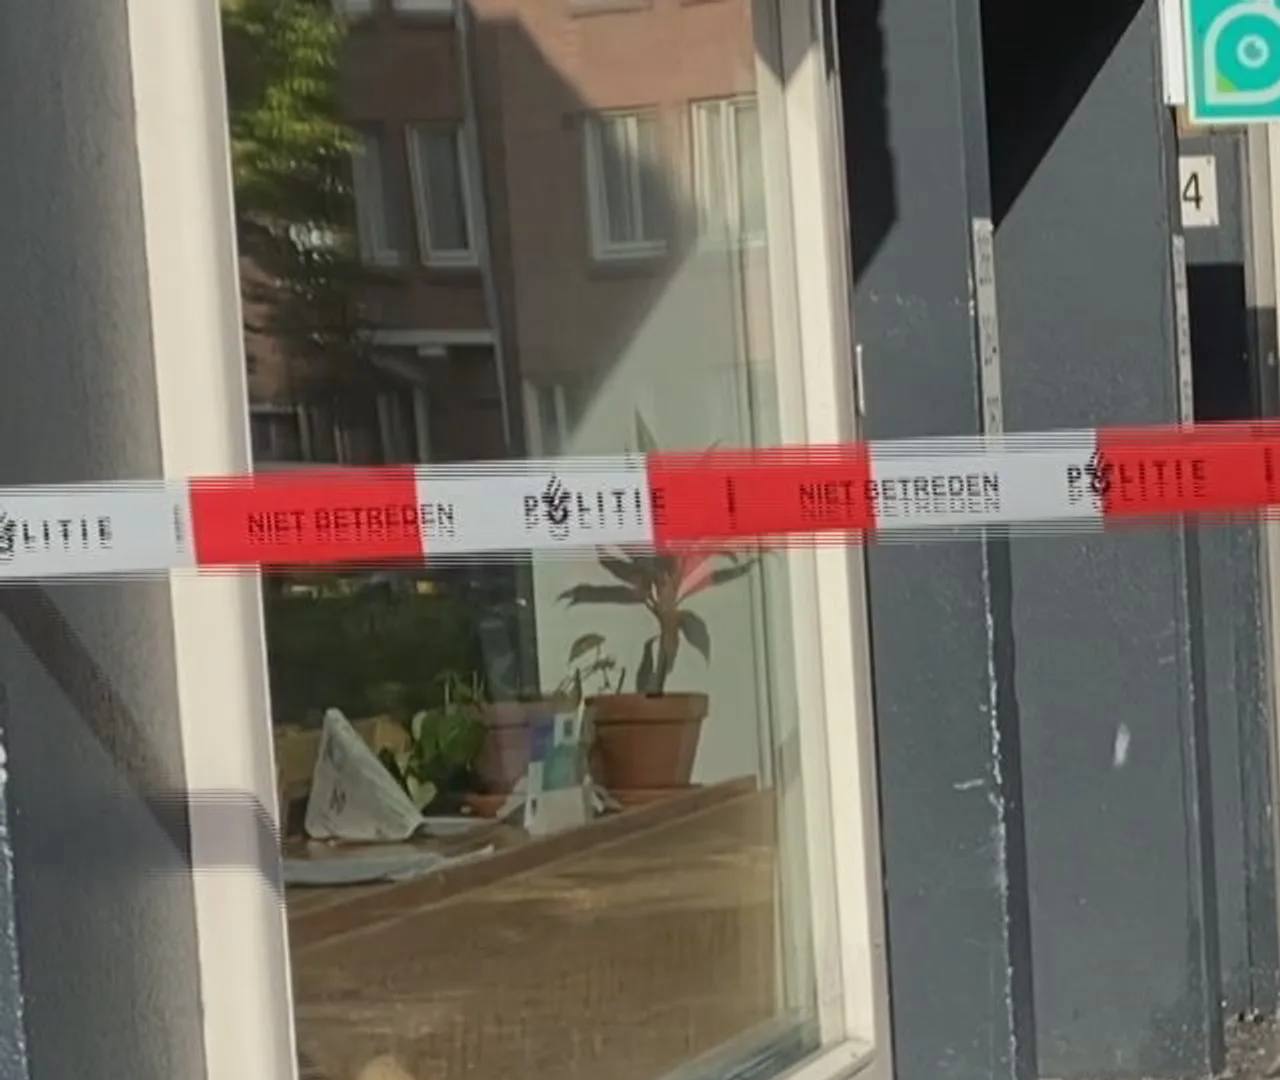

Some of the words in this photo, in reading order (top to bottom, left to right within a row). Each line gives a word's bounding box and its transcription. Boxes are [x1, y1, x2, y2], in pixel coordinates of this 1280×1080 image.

[799, 479, 855, 515] NIET
[864, 473, 1001, 517] BETREDEN
[247, 508, 305, 546] NIET
[313, 503, 457, 543] BETREDEN
